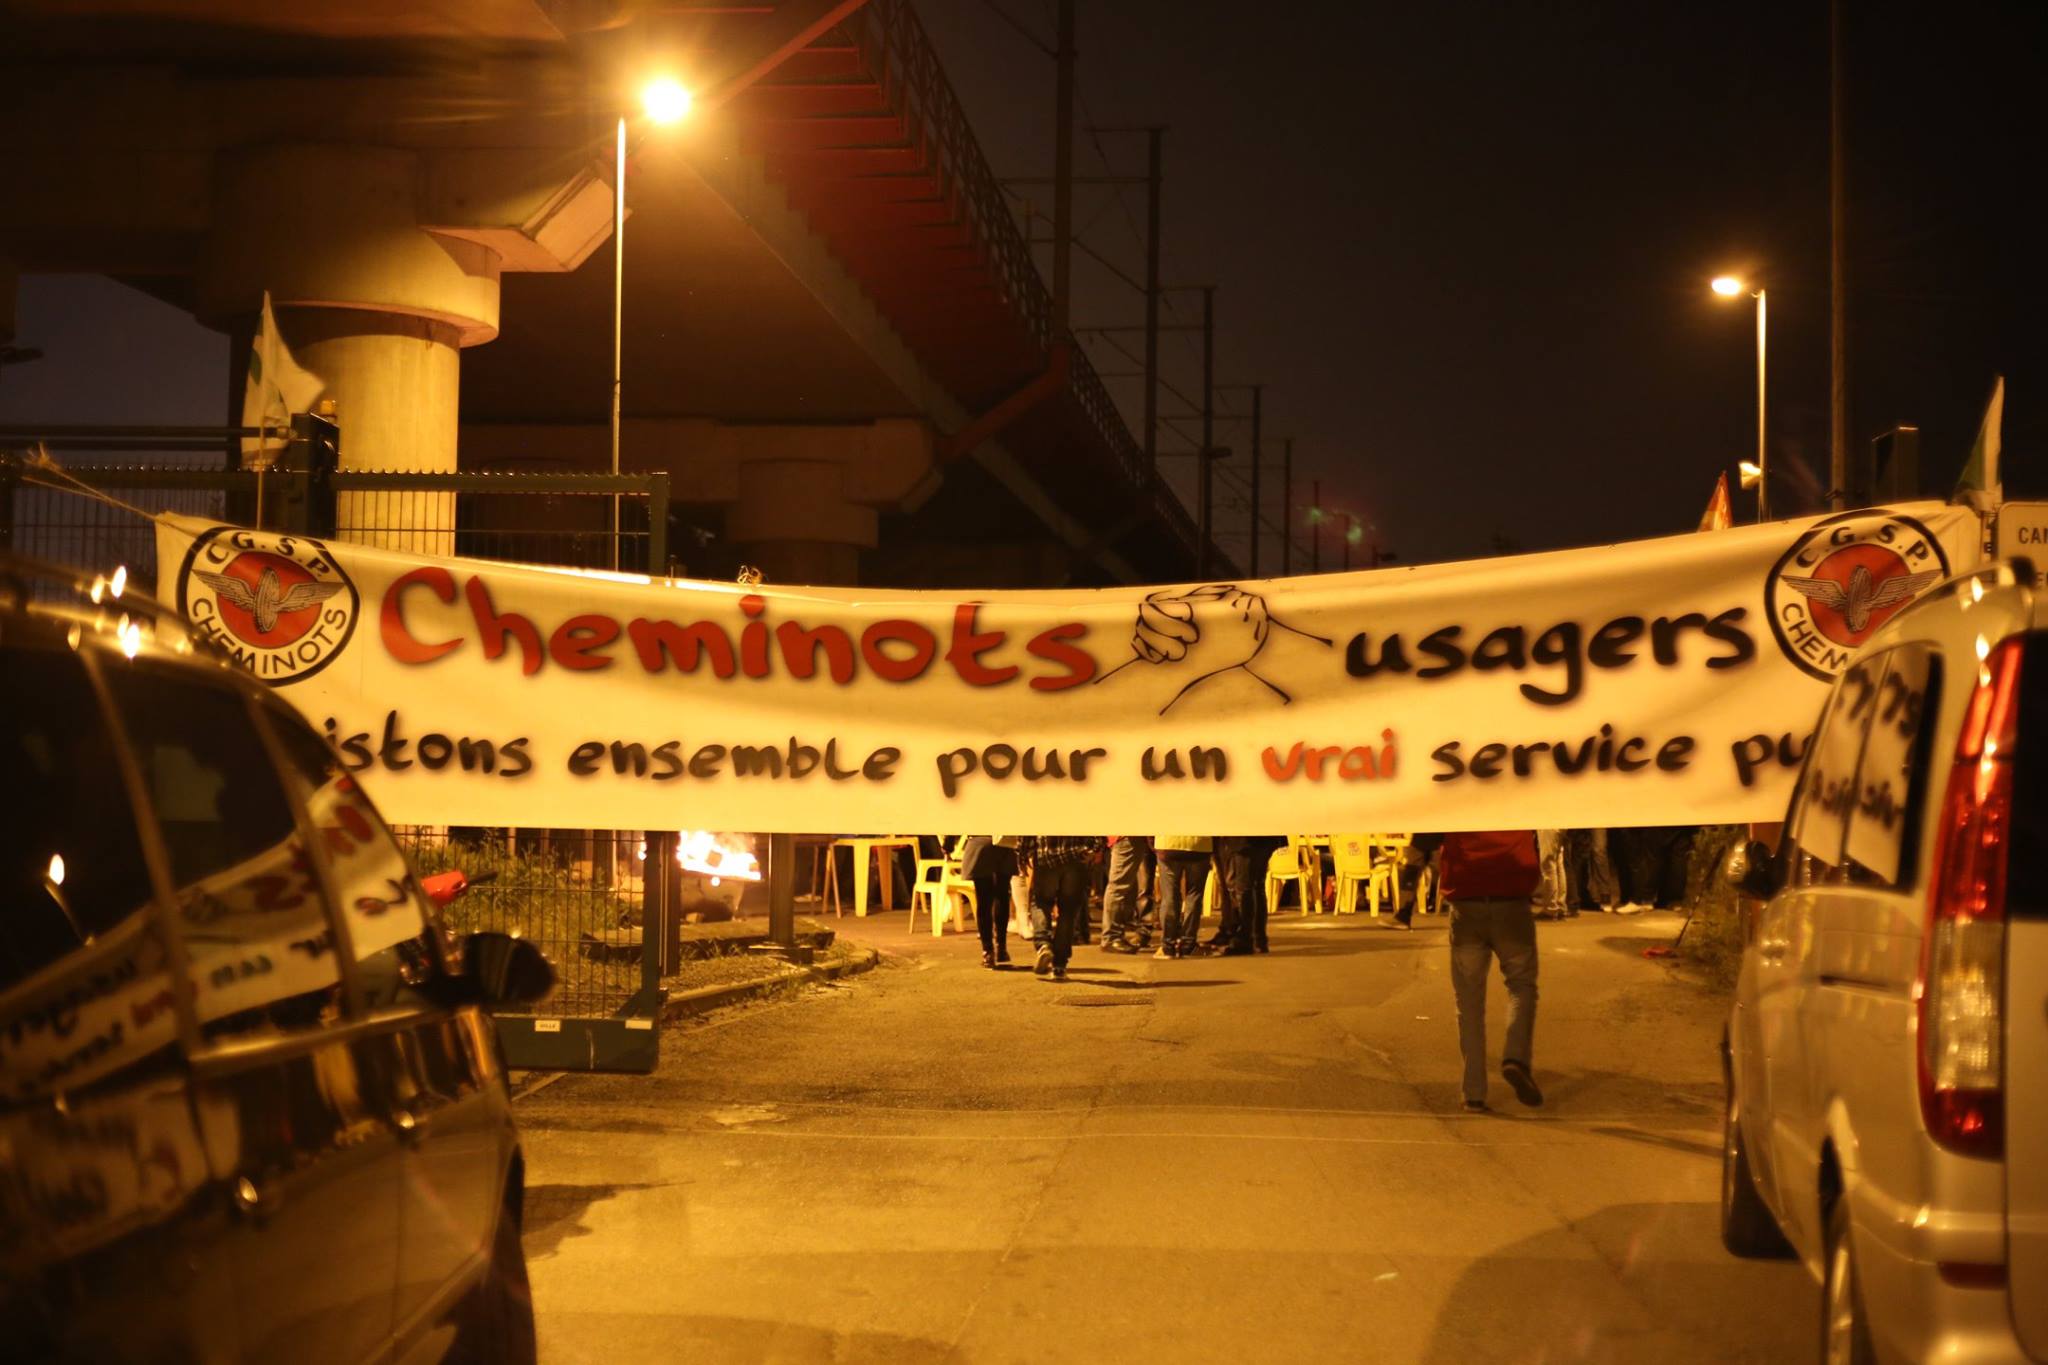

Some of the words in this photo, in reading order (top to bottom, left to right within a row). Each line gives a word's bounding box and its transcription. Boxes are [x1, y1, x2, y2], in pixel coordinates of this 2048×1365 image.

[379, 565, 1099, 693] Cheminots
[1345, 606, 1757, 707] usagers
[1782, 602, 1849, 670] CHEM
[324, 709, 532, 777] istons
[567, 736, 901, 781] ensemble
[936, 743, 1106, 798] pour
[1141, 745, 1228, 782] un
[1261, 728, 1396, 782] vrai
[1432, 723, 1696, 783] service
[1731, 731, 1814, 787] pu
